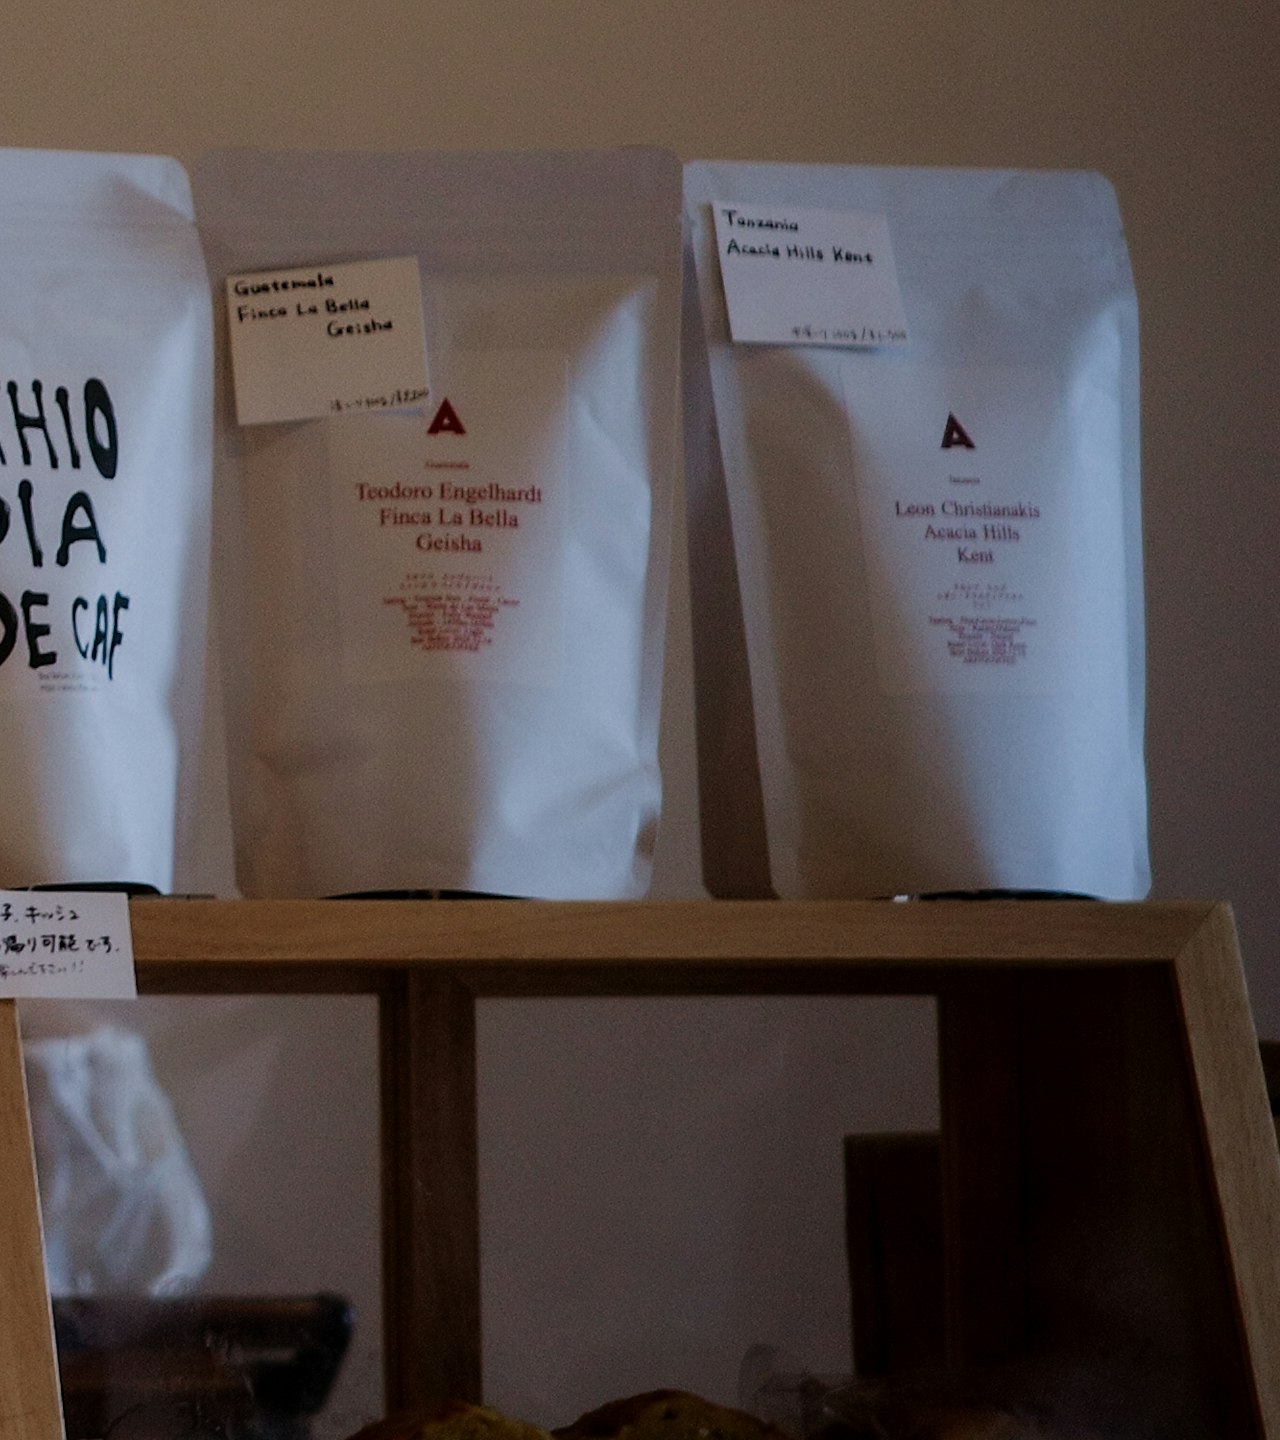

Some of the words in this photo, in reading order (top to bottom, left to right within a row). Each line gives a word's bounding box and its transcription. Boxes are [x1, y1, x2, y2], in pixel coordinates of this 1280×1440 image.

[723, 209, 798, 231] Tanzania
[727, 239, 779, 257] Acacia
[787, 244, 824, 260] Hills
[833, 246, 873, 263] Kent
[235, 273, 334, 296] Guatemala
[237, 304, 287, 321] Finca
[297, 303, 318, 316] La
[325, 298, 370, 313] Bella
[327, 319, 393, 337] Geisha
[355, 482, 433, 502] Teodoro
[440, 482, 542, 503] Engelhardt
[380, 507, 431, 526] Finca
[439, 508, 463, 525] La
[470, 509, 519, 528] Bella
[895, 501, 935, 517] Leon
[941, 501, 1041, 518] Christianakis
[416, 533, 482, 552] Geisha
[924, 524, 977, 540] Acacia
[983, 524, 1020, 541] Hills
[958, 547, 994, 563] Kent
[73, 591, 129, 680] CAF
